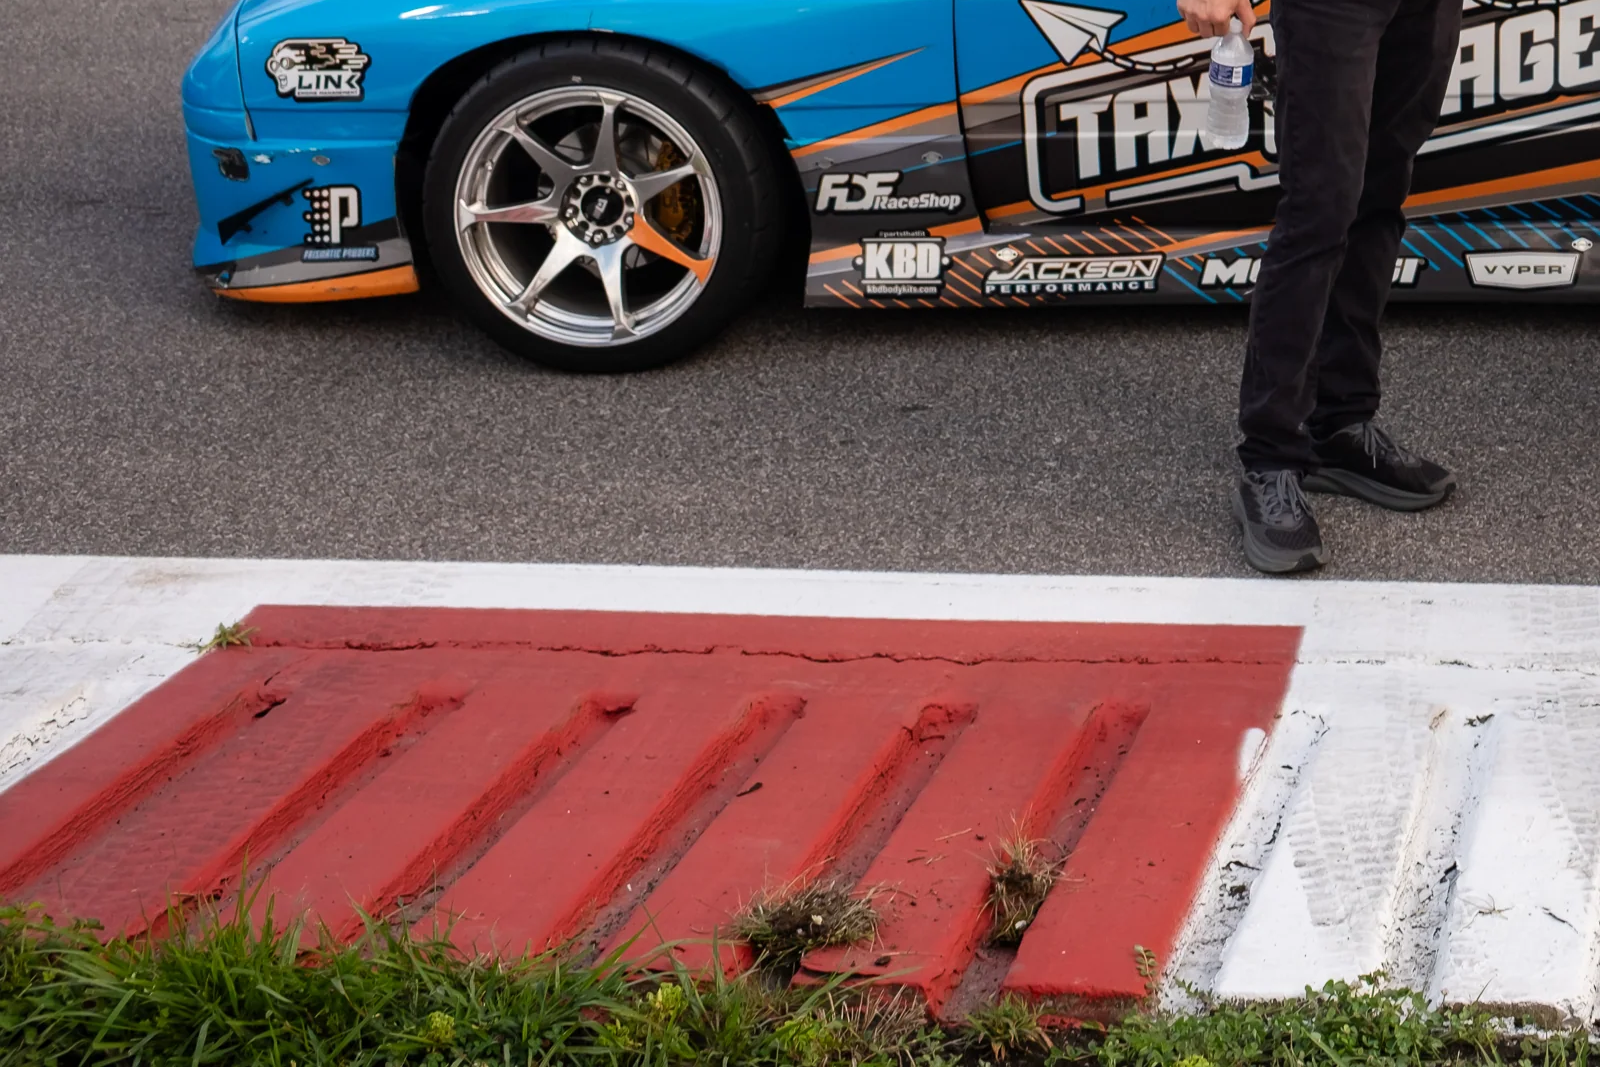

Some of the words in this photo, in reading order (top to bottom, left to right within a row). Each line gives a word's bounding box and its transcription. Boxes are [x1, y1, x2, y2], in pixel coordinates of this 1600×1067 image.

[1060, 72, 1215, 180] TAX
[816, 172, 899, 212] FDF
[873, 192, 961, 211] RaceShop
[865, 242, 941, 280] KBD
[987, 255, 1163, 282] JACKSON
[1484, 264, 1564, 276] VYPER
[867, 285, 938, 296] kbdbodykits.com
[986, 279, 1156, 295] PERFORMANCE
